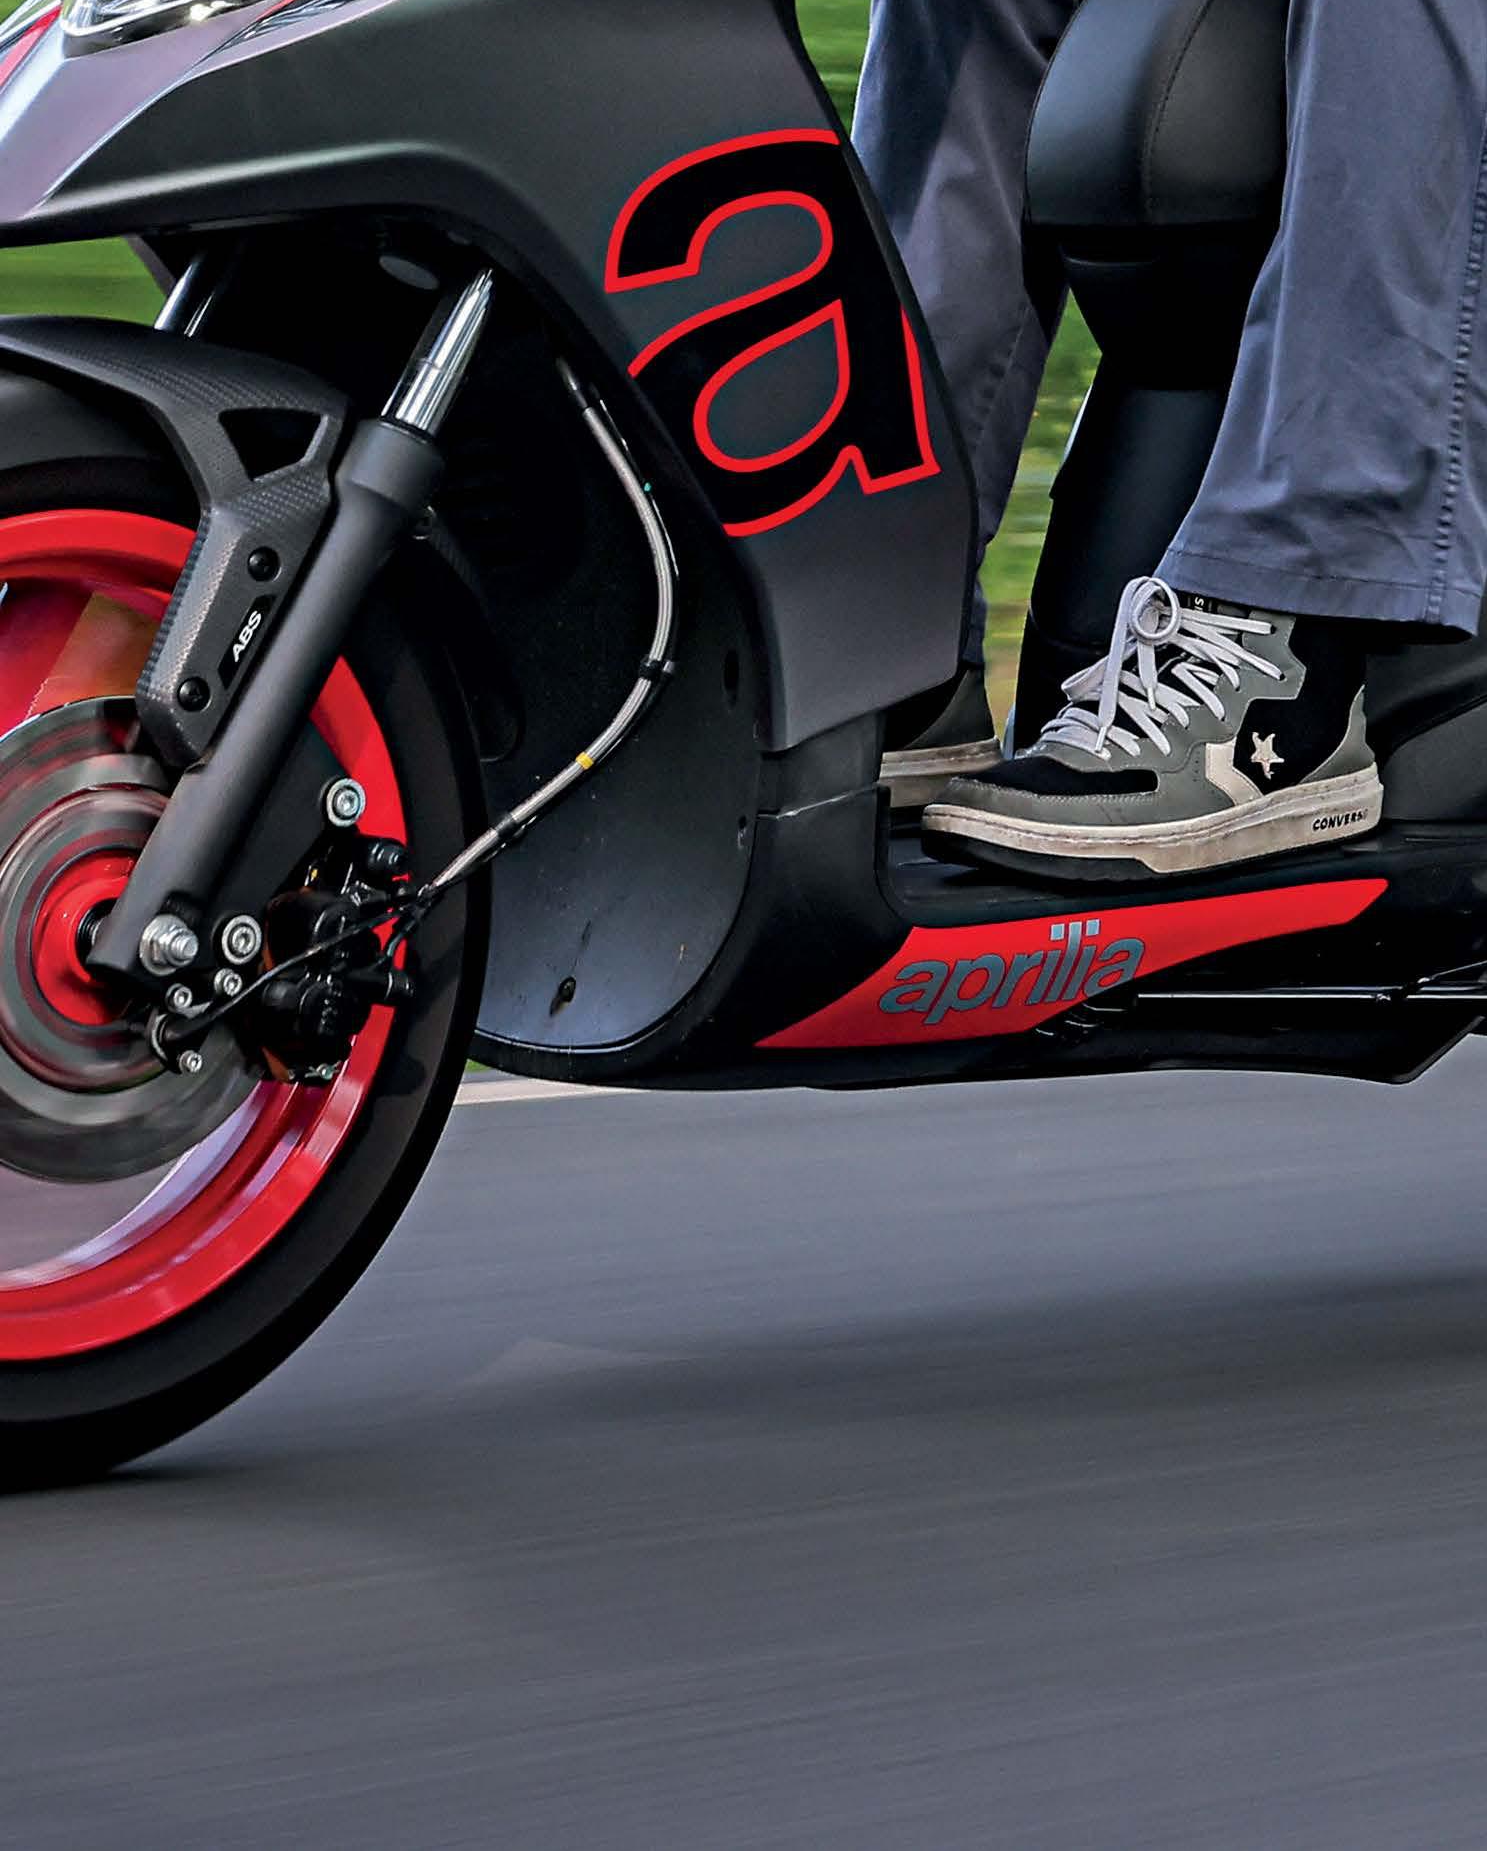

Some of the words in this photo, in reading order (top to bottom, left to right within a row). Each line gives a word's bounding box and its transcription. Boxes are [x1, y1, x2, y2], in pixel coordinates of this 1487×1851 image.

[605, 128, 941, 538] a
[232, 610, 262, 663] ABS
[1312, 808, 1368, 831] CONVERS
[879, 919, 1145, 1026] aprilia
